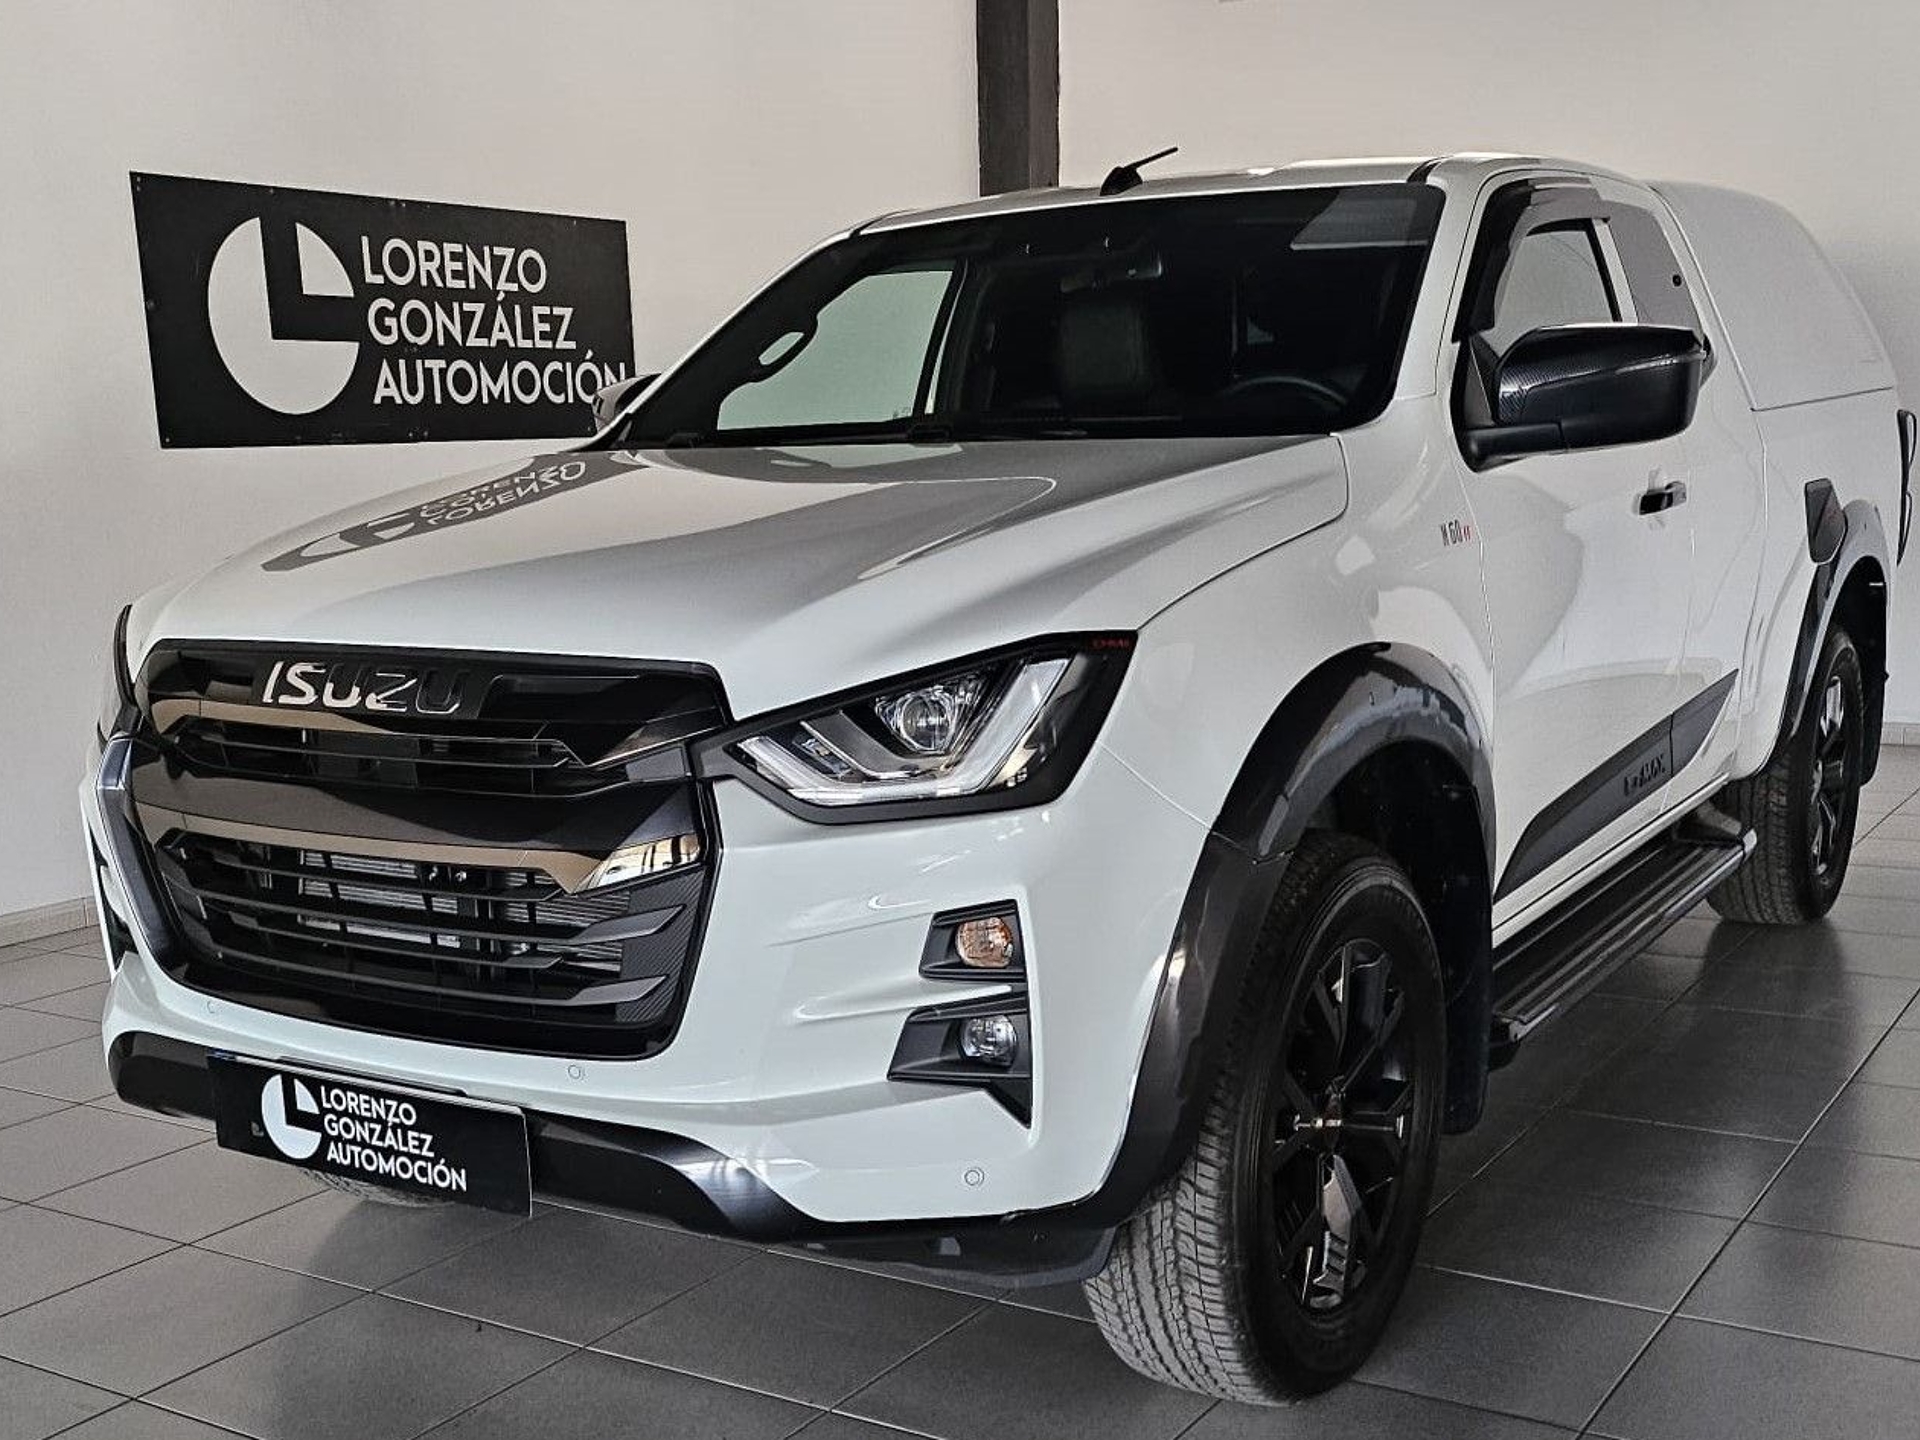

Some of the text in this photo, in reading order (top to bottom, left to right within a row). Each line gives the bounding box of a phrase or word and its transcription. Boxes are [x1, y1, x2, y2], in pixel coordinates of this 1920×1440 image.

[361, 235, 547, 293] LORENZO
[368, 292, 577, 349] GONZÁLEZ
[262, 660, 470, 714] ISUZU
[321, 1086, 417, 1126] LORENZO
[323, 1113, 435, 1157] GONZÁLEZ
[327, 1142, 467, 1191] AUTOMOCIÓN
